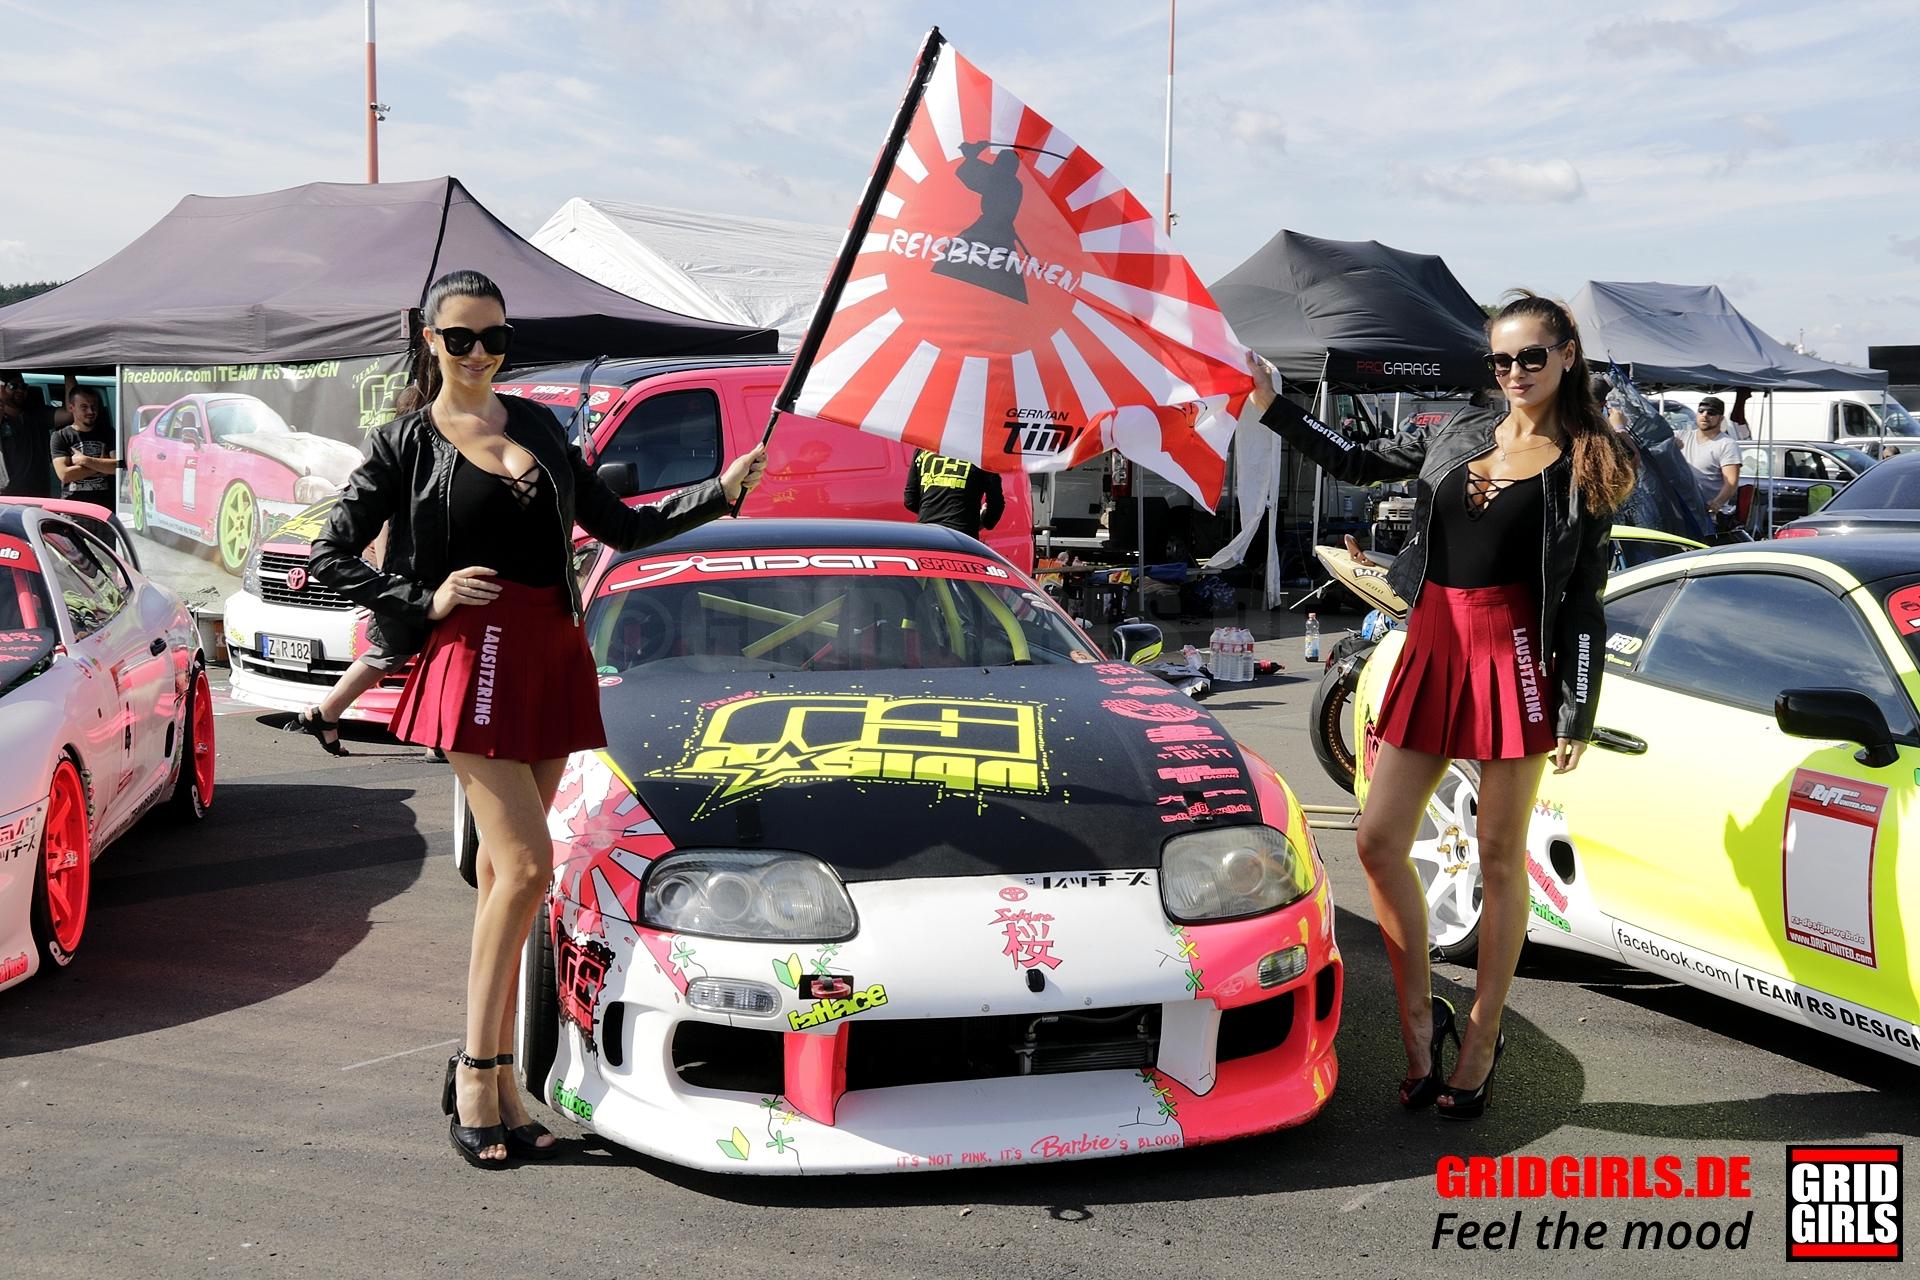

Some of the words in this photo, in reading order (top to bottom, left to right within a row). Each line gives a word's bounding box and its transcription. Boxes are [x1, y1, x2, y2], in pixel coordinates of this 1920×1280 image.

[888, 229, 1080, 294] REISBRENNEN
[1006, 408, 1069, 421] GERMAN
[291, 642, 309, 660] 182
[474, 625, 502, 725] LAUSITZRING
[1512, 627, 1543, 723] LAUSITZRING
[1576, 633, 1590, 704] LAUSITZRING
[1001, 922, 1063, 970] 桜
[1617, 928, 1732, 984] facebook.com
[1742, 973, 1804, 1009] TEAM
[1806, 994, 1836, 1020] RS
[1790, 932, 1873, 966] www.DRIFTUNITED.com
[928, 1153, 953, 1167] NOT
[1137, 1132, 1180, 1149] BLOOD
